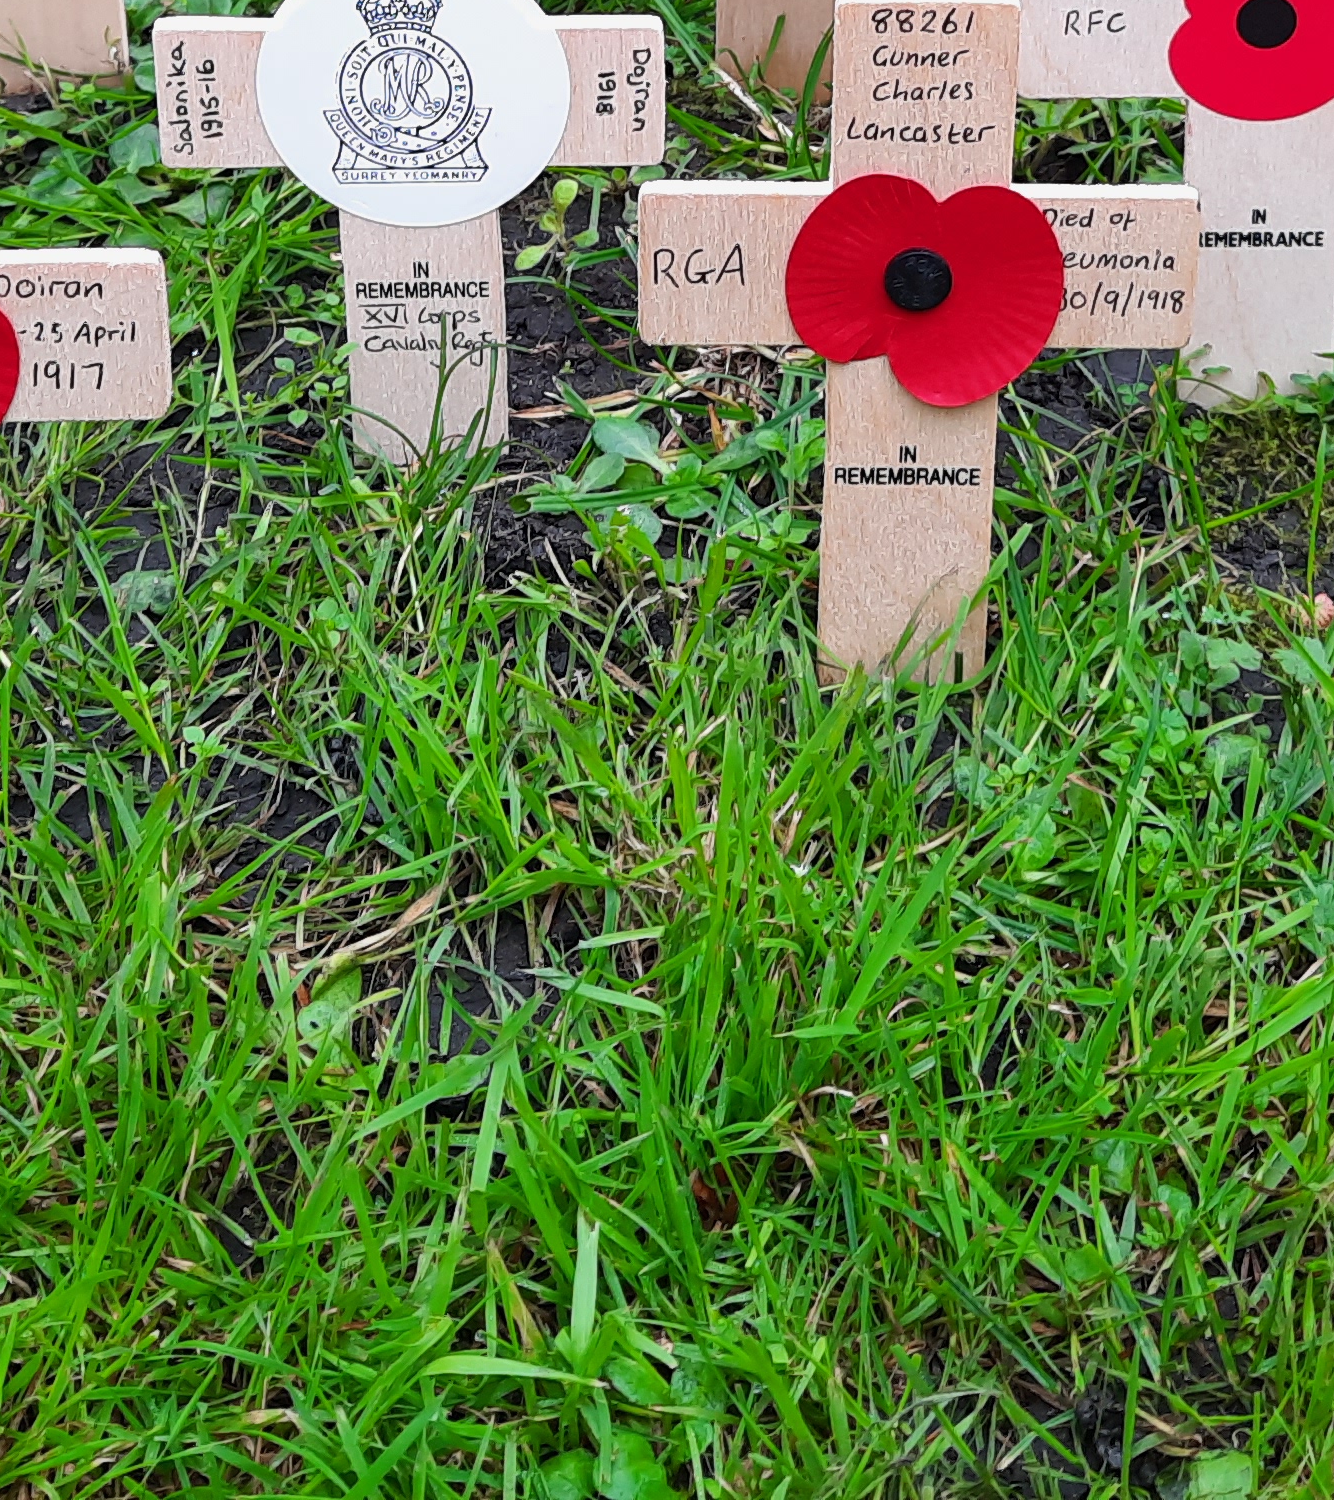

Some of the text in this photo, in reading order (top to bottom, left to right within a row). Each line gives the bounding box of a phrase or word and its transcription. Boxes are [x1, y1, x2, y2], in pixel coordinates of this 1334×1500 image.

[871, 8, 975, 34] 88261
[1063, 9, 1127, 36] RFC
[346, 45, 373, 81] SOIT
[872, 45, 971, 67] Gunner
[165, 40, 194, 156] Salonika
[195, 59, 224, 139] 1915-16
[595, 71, 617, 117] 1918
[627, 48, 652, 132] Dojran
[872, 78, 974, 101] Charles
[329, 112, 366, 152] QUEEN
[425, 111, 486, 164] REGIMENT
[847, 116, 996, 144] Lancaster
[1043, 207, 1136, 232] Died of
[1252, 209, 1267, 224] IN
[413, 262, 429, 278] IN
[652, 243, 747, 287] RGA
[1063, 249, 1176, 272] eumonia
[356, 280, 490, 299] REMEMBRANCE
[417, 306, 482, 331] Corps
[73, 320, 137, 348] April
[33, 360, 104, 390] 1917
[899, 446, 917, 465] IN
[834, 467, 982, 488] REMEMBRANCE
